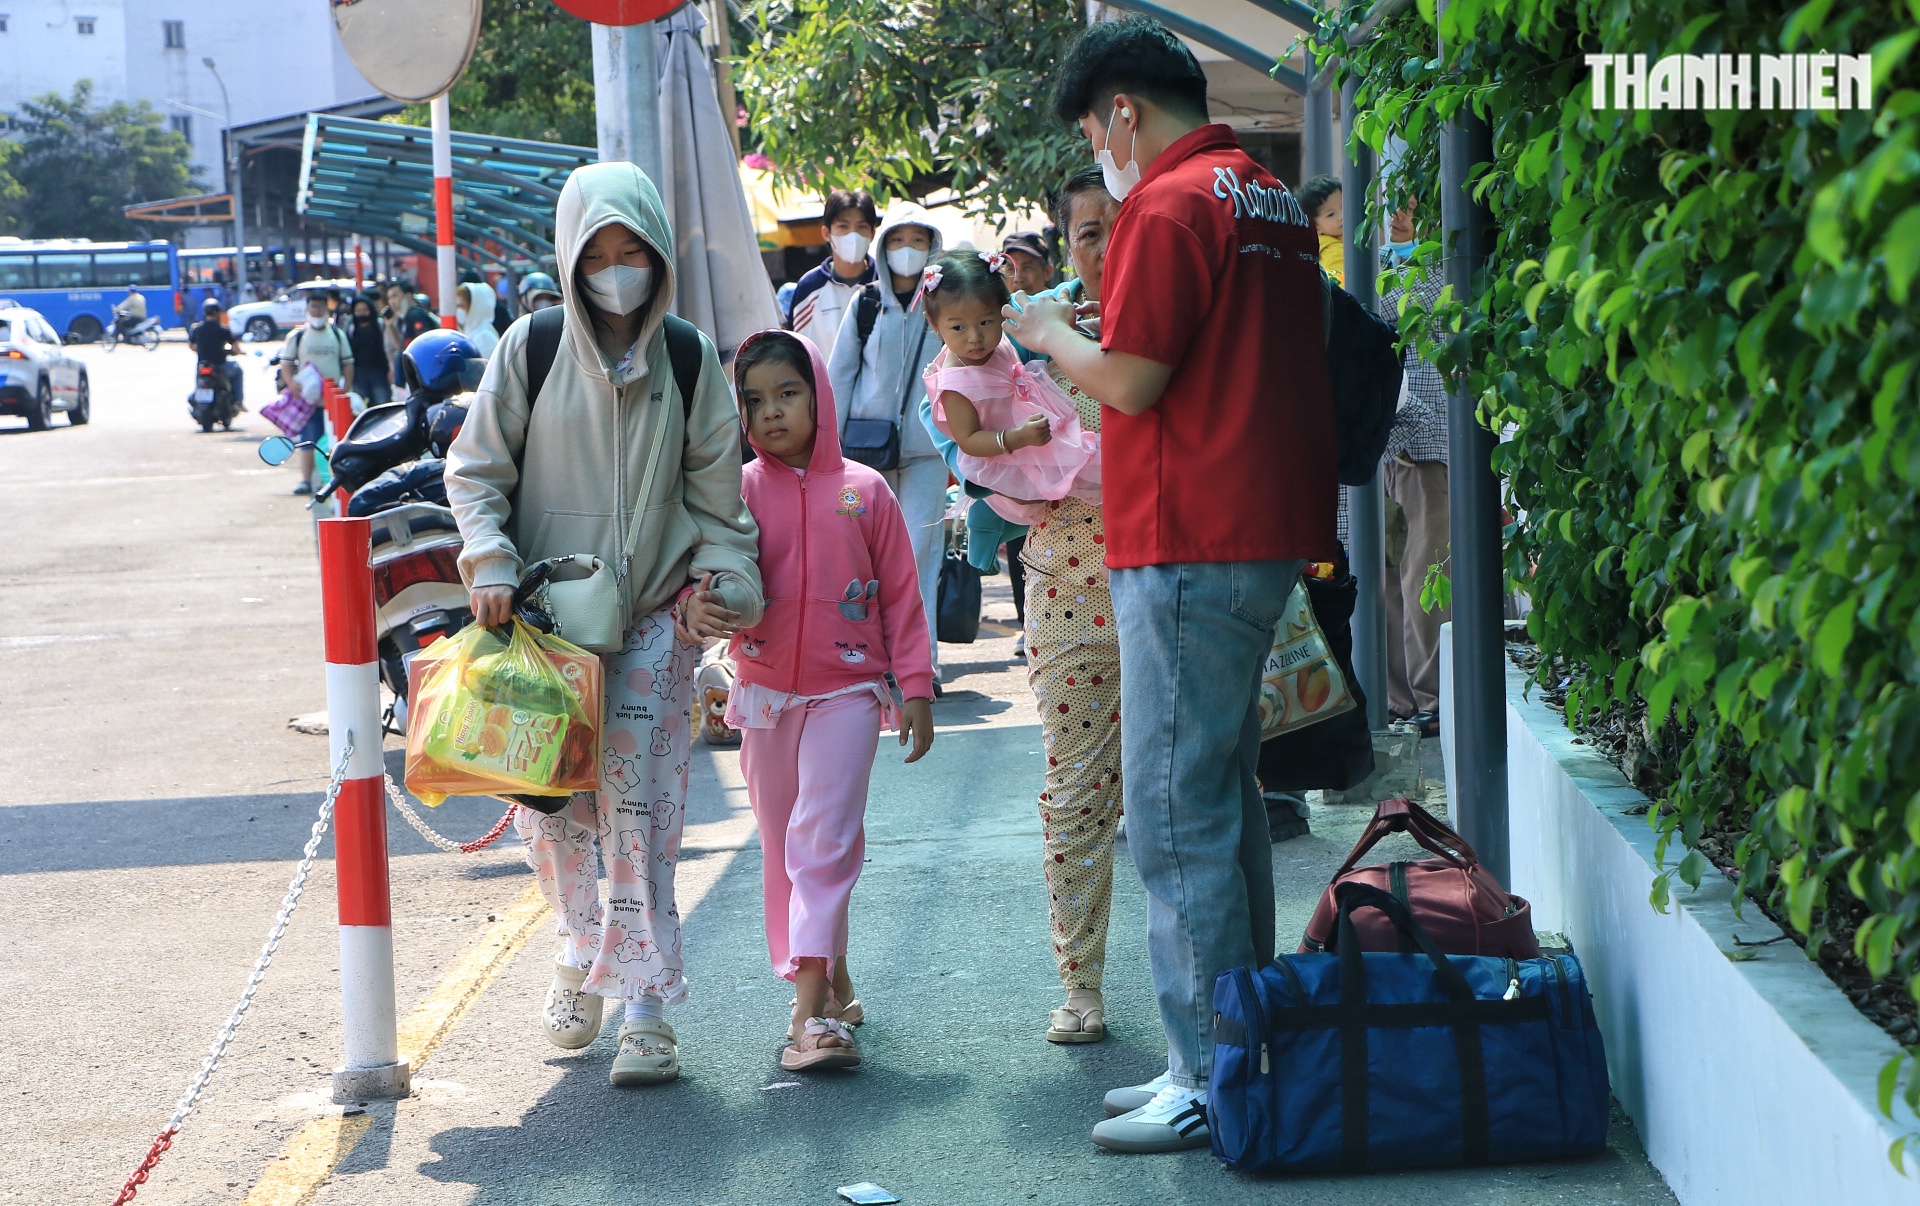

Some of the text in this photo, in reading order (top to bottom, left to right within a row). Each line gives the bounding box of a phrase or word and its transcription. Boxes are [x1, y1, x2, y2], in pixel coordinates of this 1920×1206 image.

[620, 703, 648, 713] bunny
[615, 711, 654, 721] Good luck
[621, 798, 648, 810] bunny
[616, 807, 633, 816] luck
[608, 897, 645, 908] Good luck
[613, 905, 641, 914] bunny
